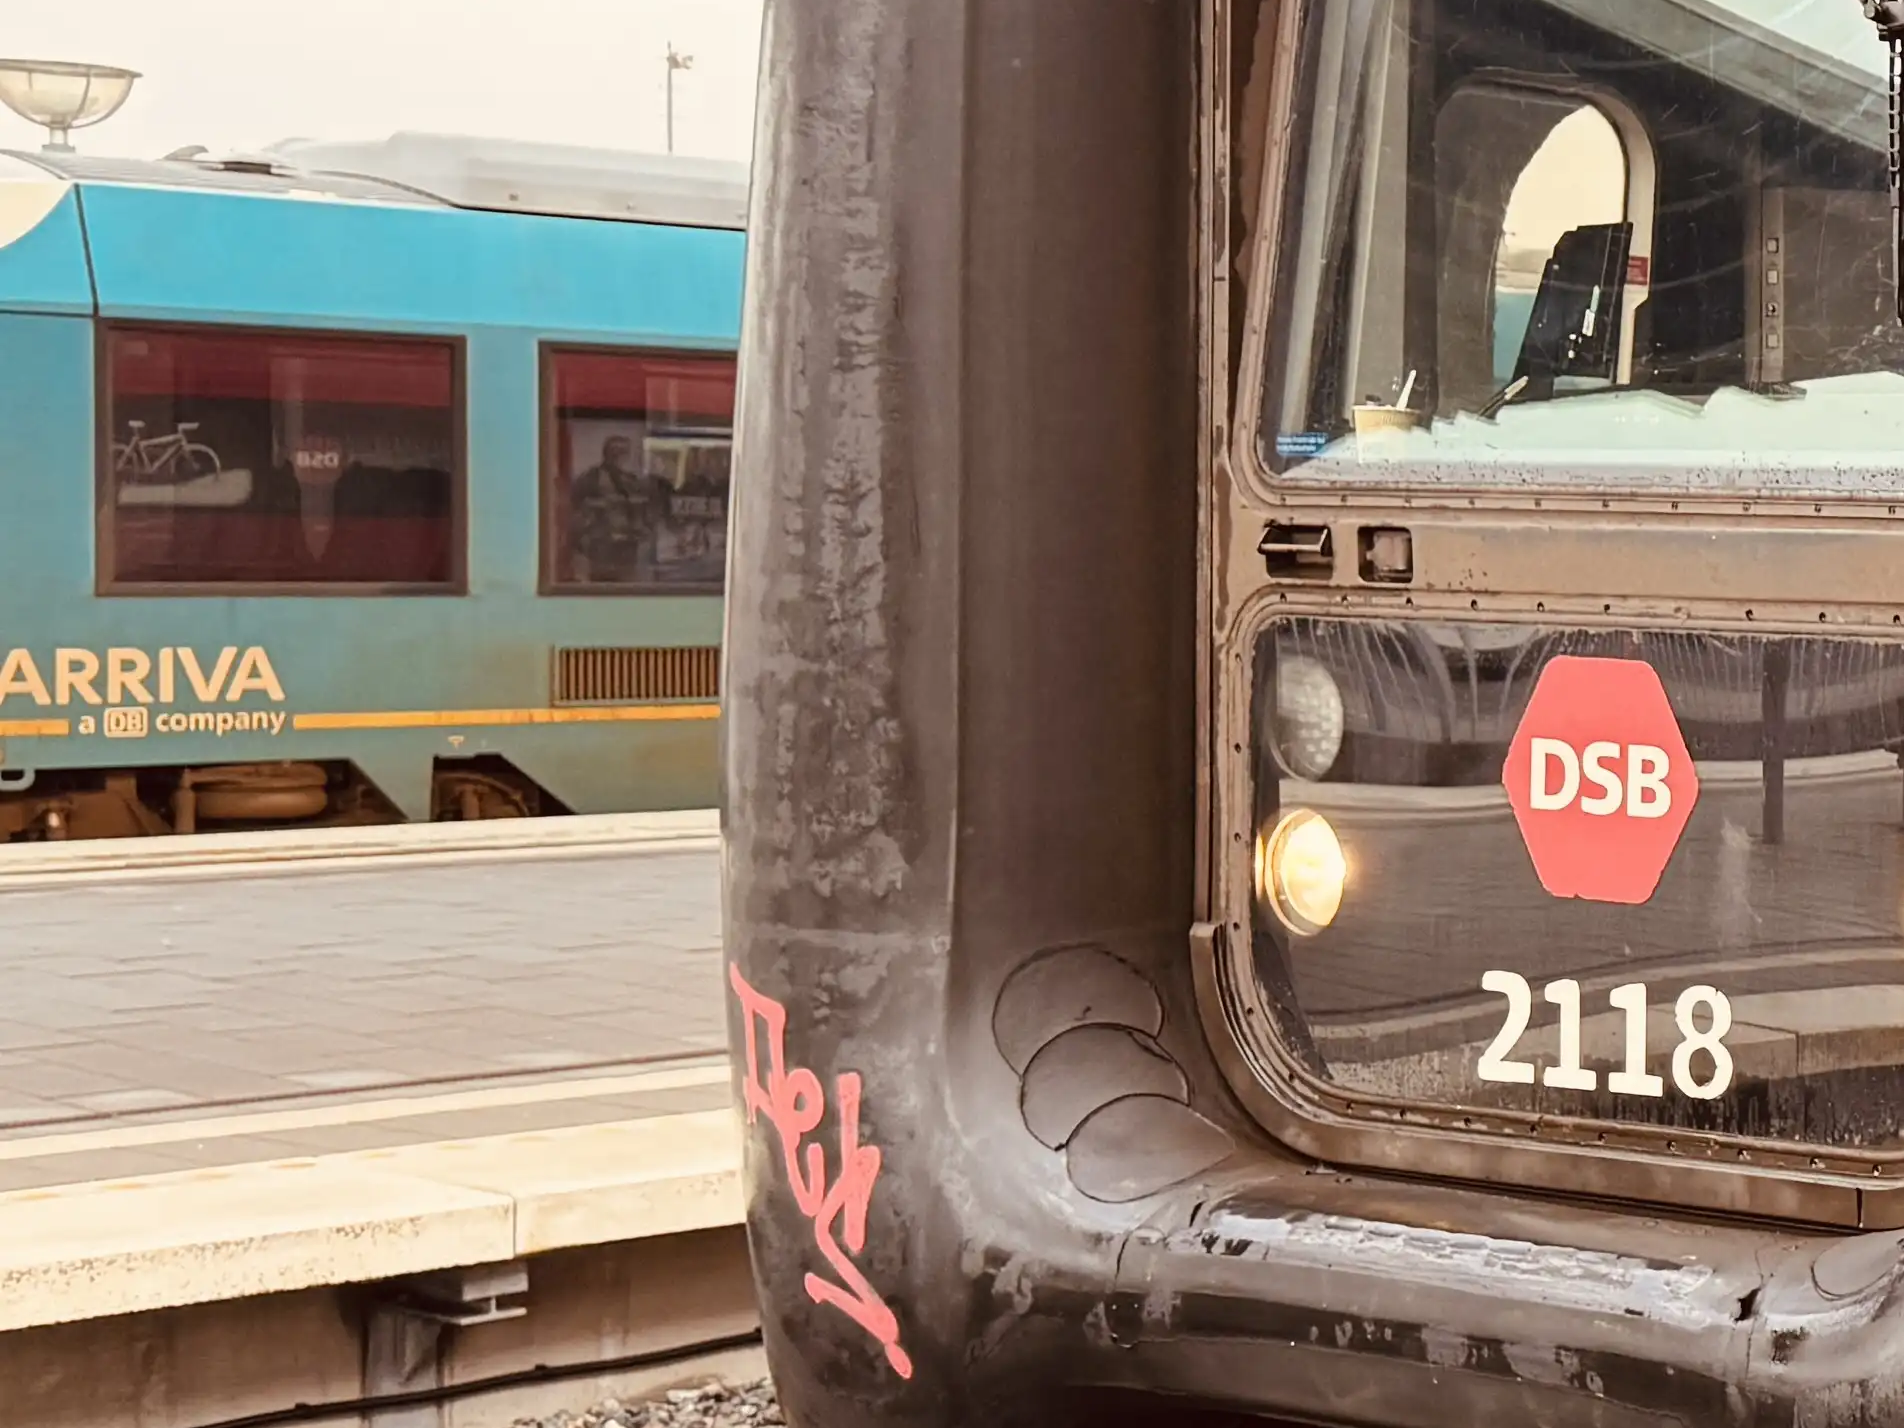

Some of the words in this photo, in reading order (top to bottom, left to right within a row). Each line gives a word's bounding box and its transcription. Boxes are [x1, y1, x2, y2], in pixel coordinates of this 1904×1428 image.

[0, 646, 286, 705] ARRIVA
[78, 715, 96, 734] a
[107, 710, 146, 734] DB
[155, 711, 286, 737] company
[1530, 737, 1672, 819] DSB
[1477, 970, 1734, 1101] 2118
